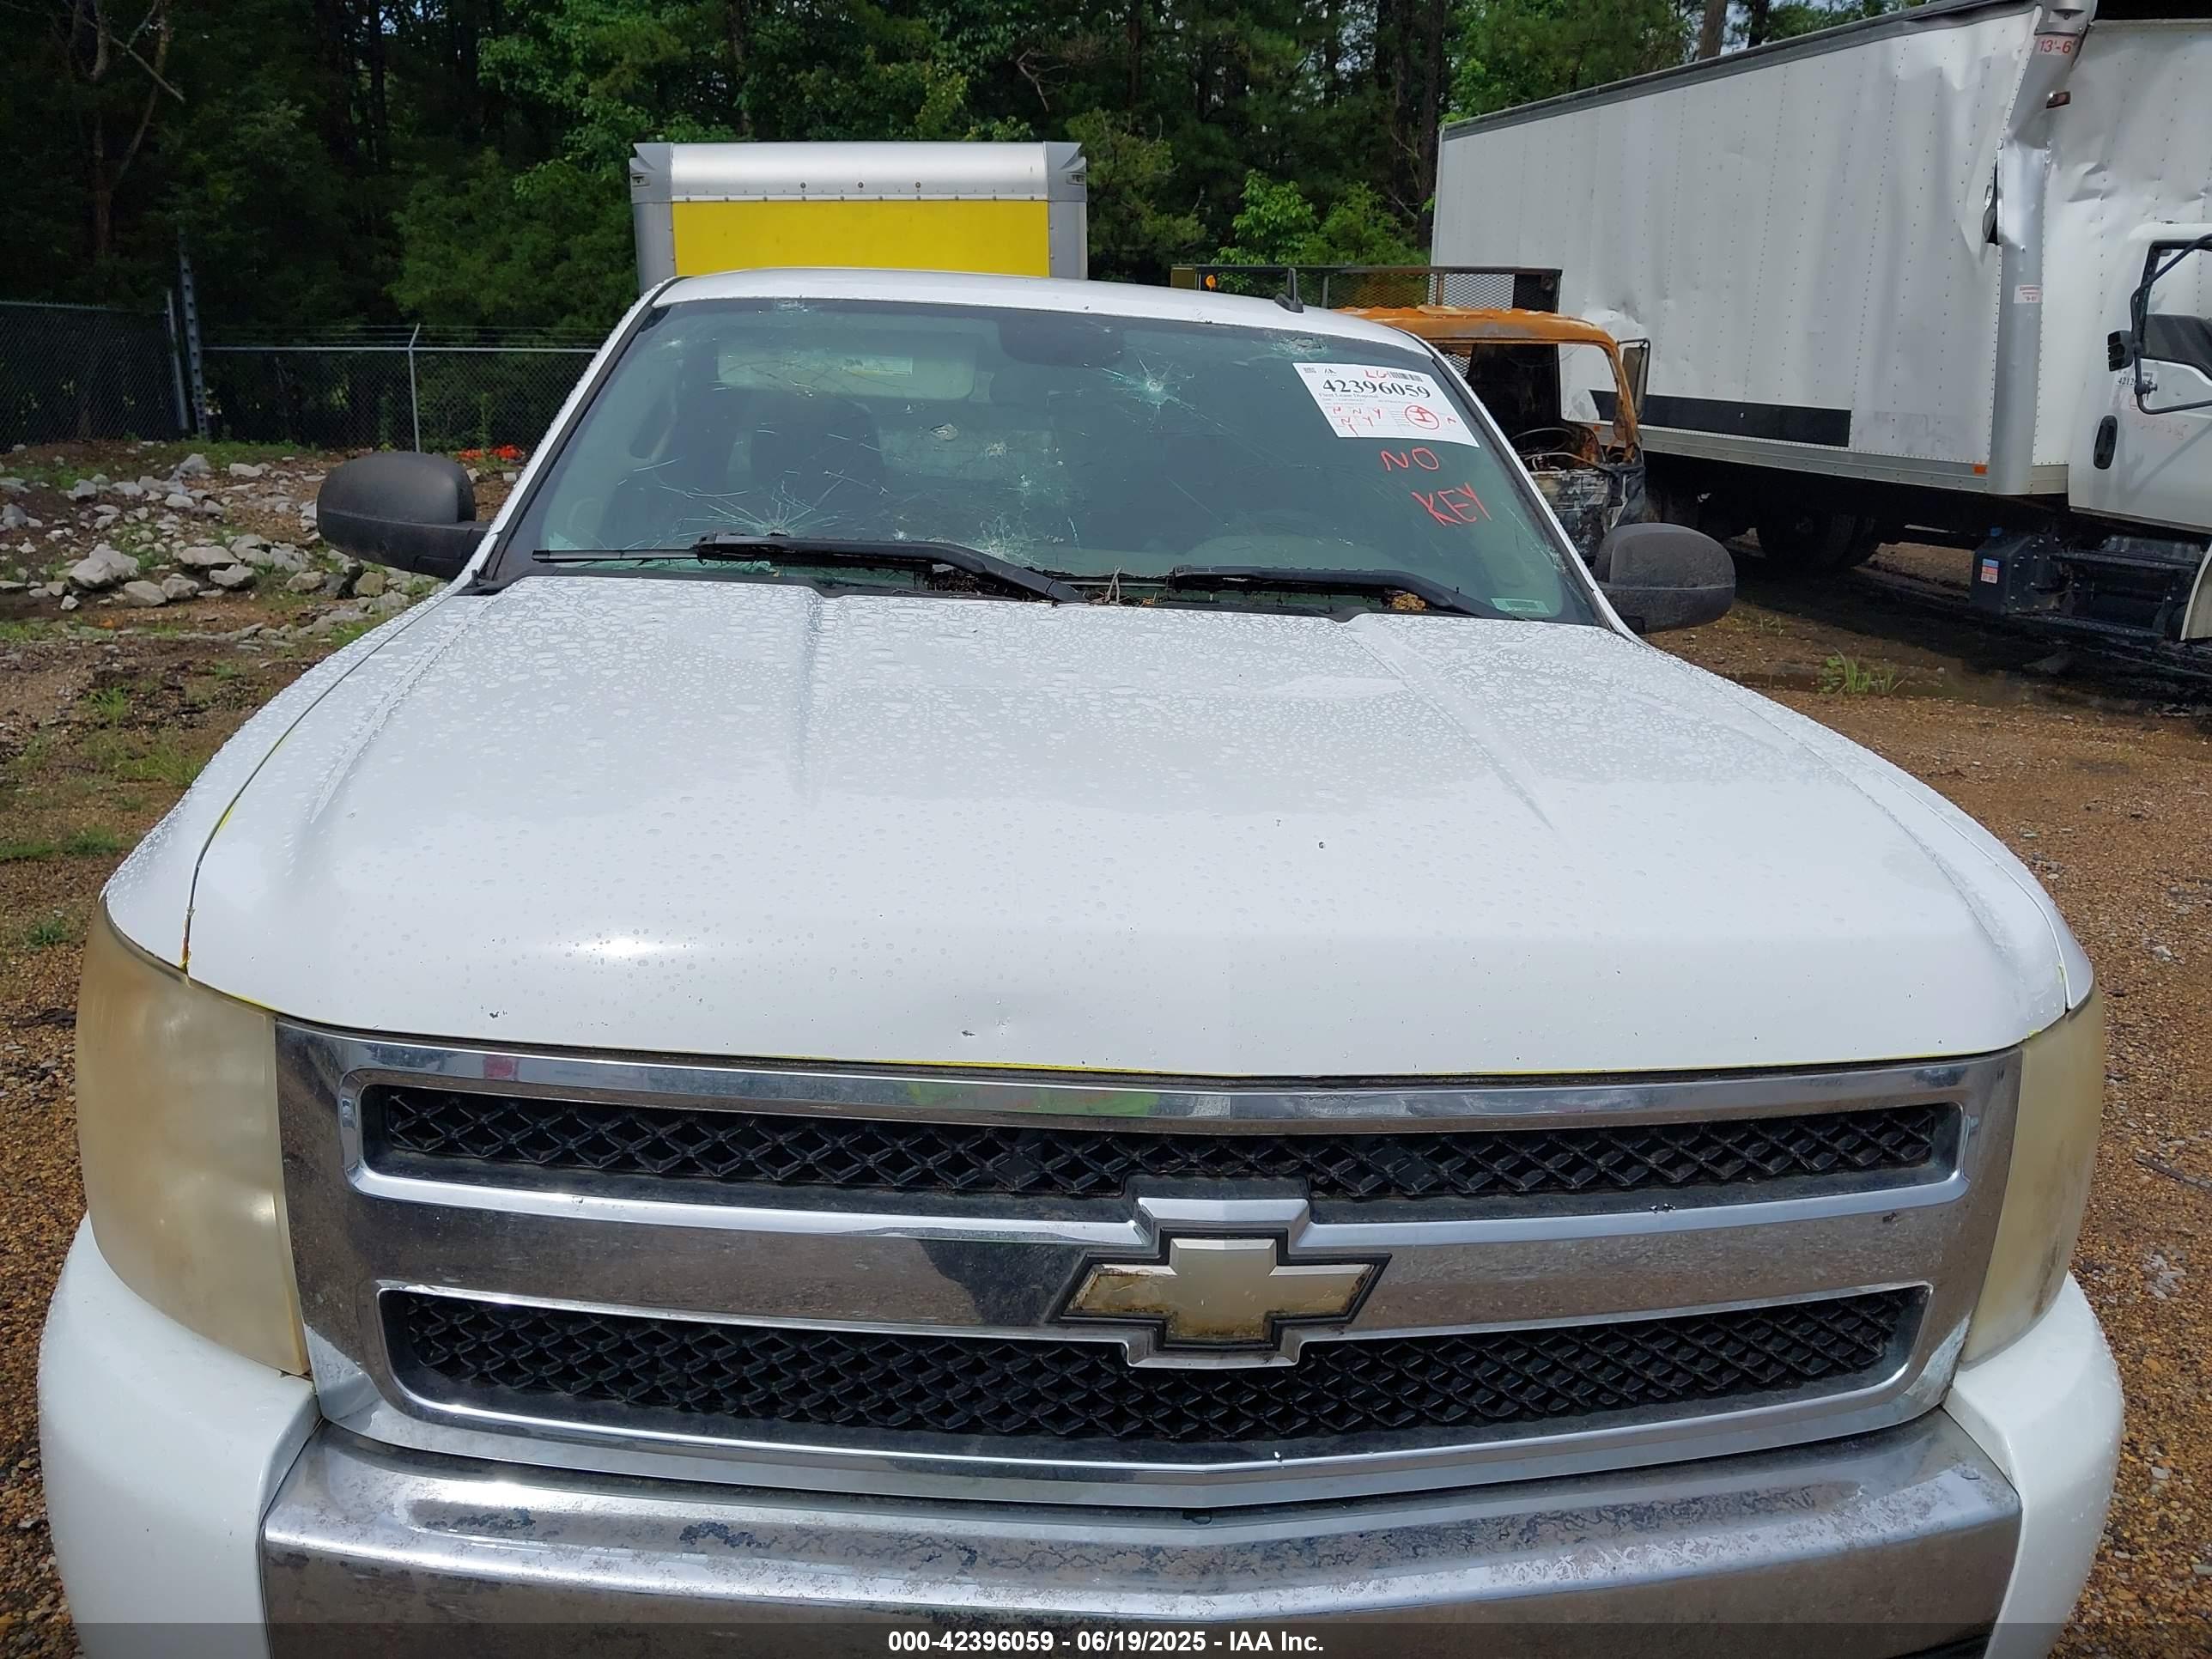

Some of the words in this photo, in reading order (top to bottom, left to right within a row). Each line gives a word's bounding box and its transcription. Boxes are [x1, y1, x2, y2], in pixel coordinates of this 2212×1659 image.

[1322, 379, 1431, 398] 42396059
[1381, 447, 1439, 471] NO
[1411, 482, 1492, 526] KEY
